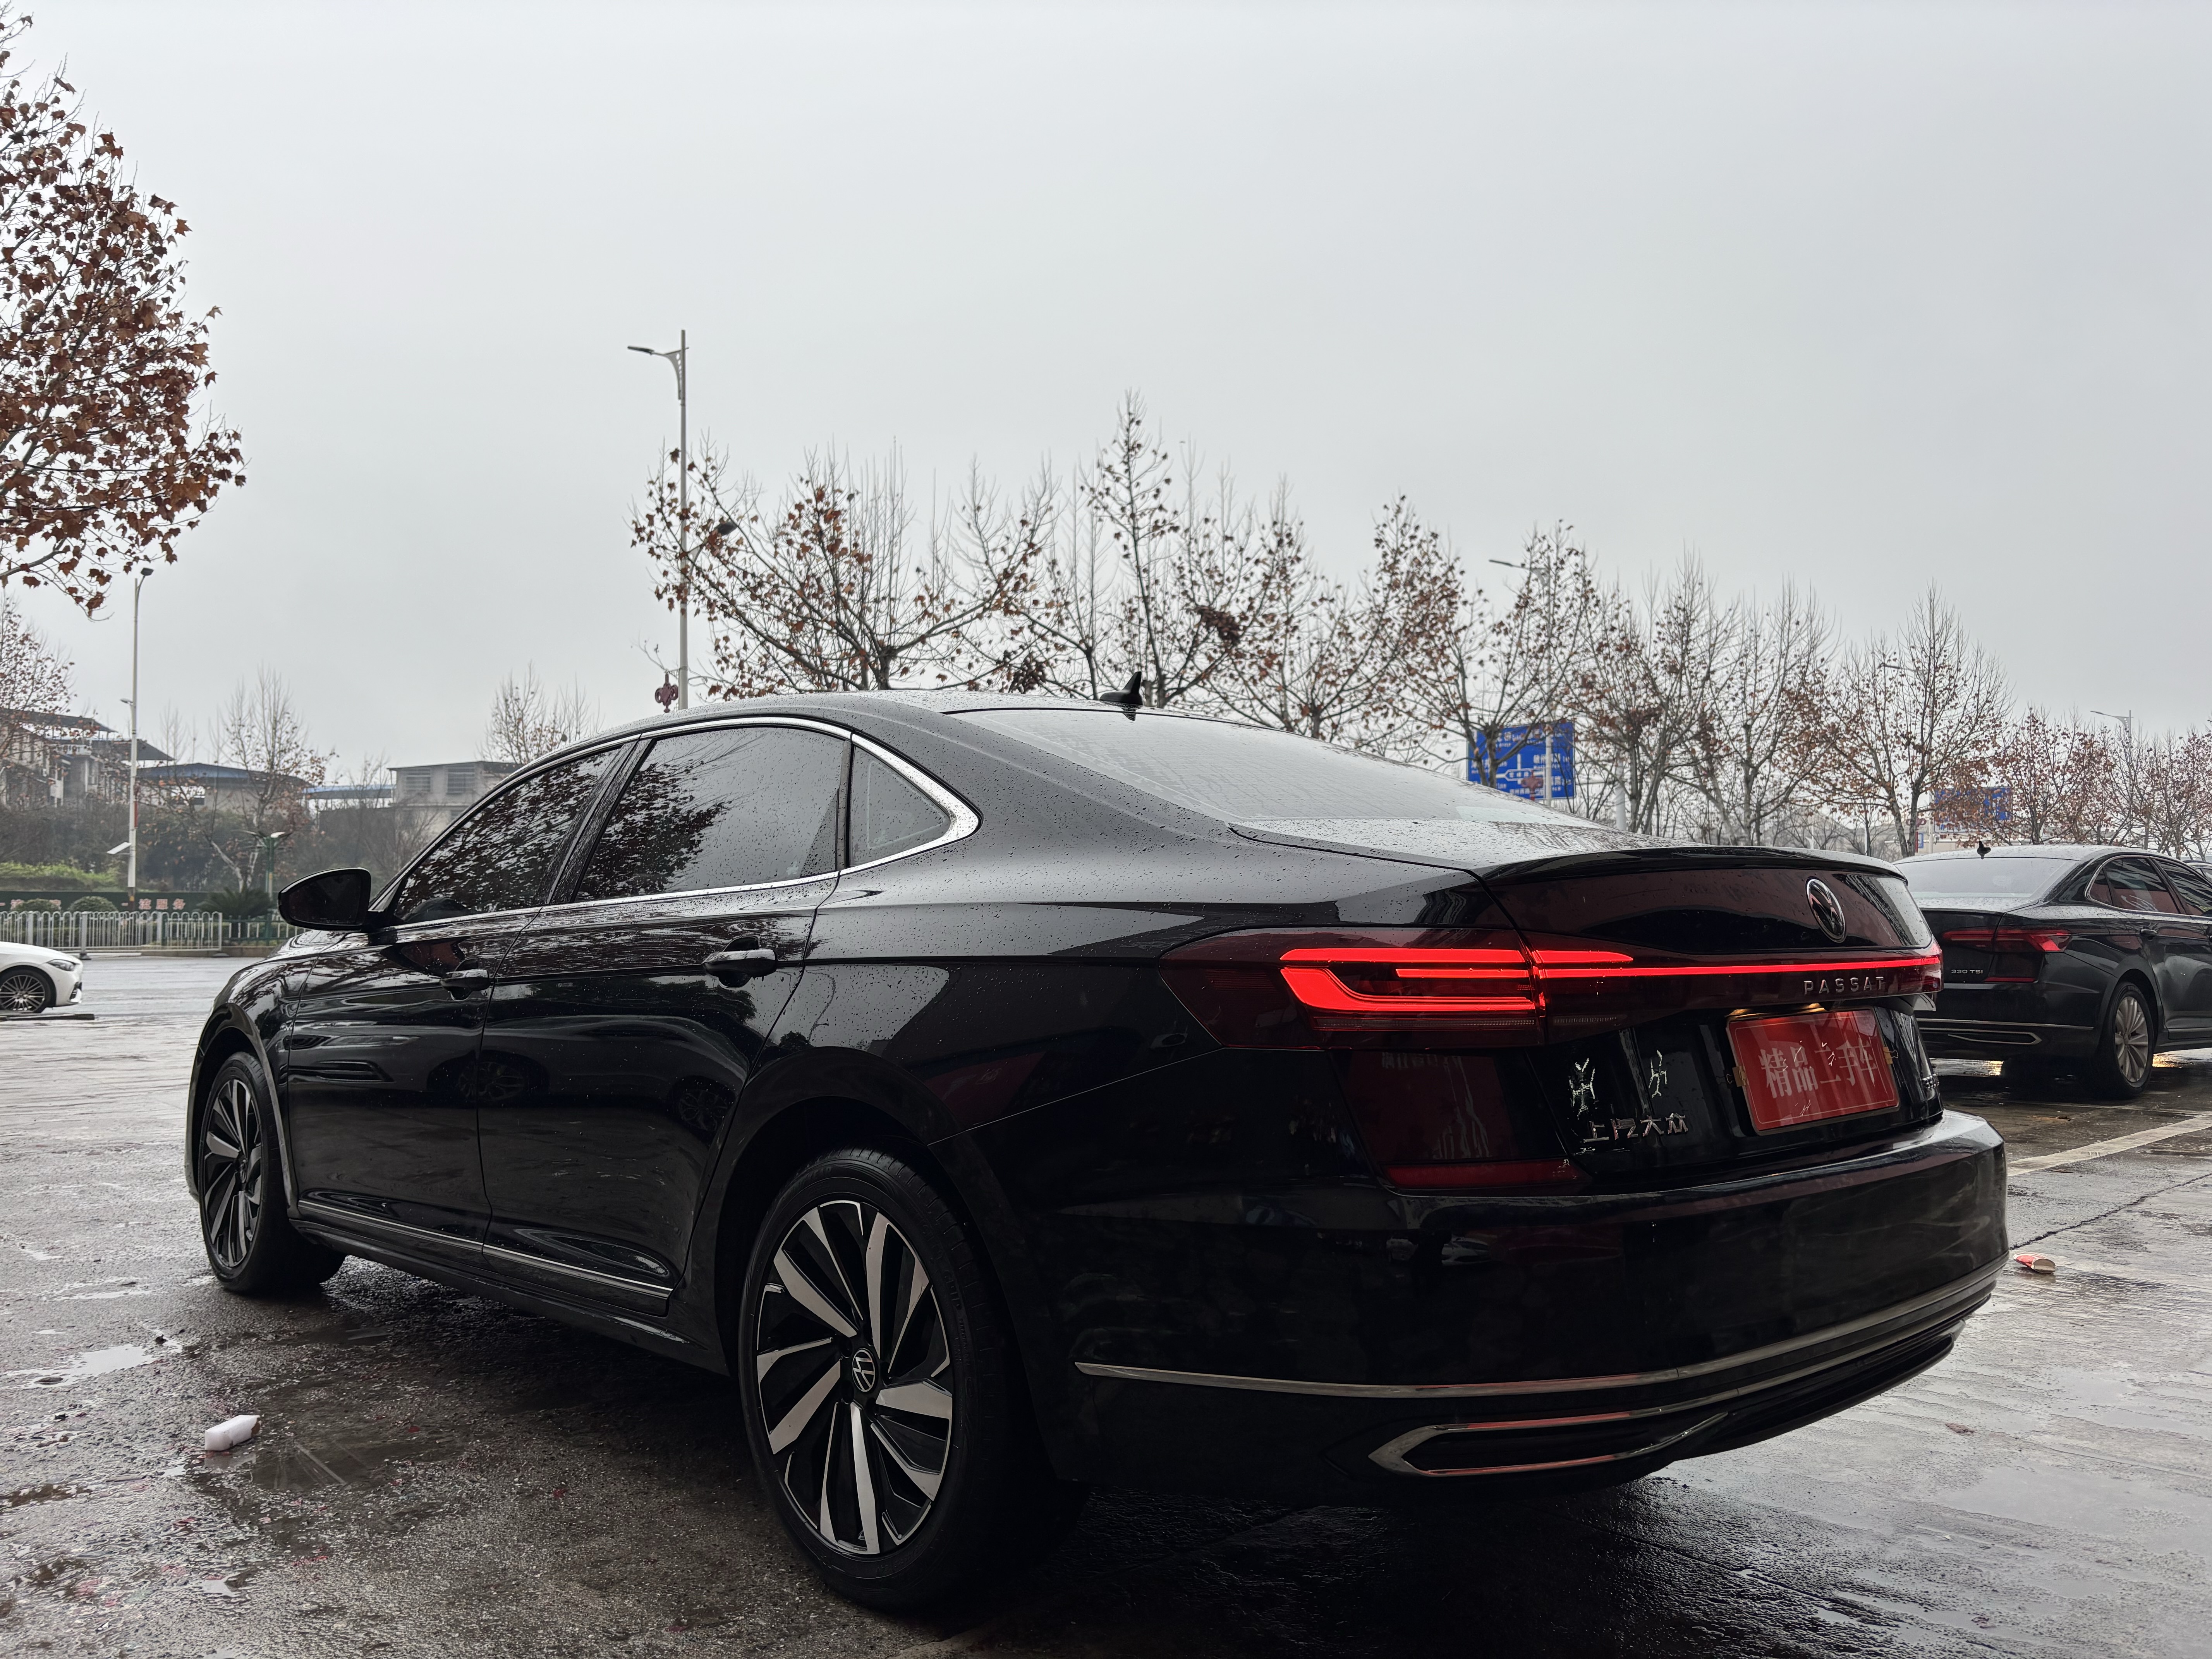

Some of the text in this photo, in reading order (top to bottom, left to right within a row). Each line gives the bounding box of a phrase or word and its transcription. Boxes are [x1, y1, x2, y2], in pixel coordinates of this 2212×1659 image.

[1803, 976, 1884, 996] PASSAT
[1759, 1034, 1878, 1099] 精品二手车
